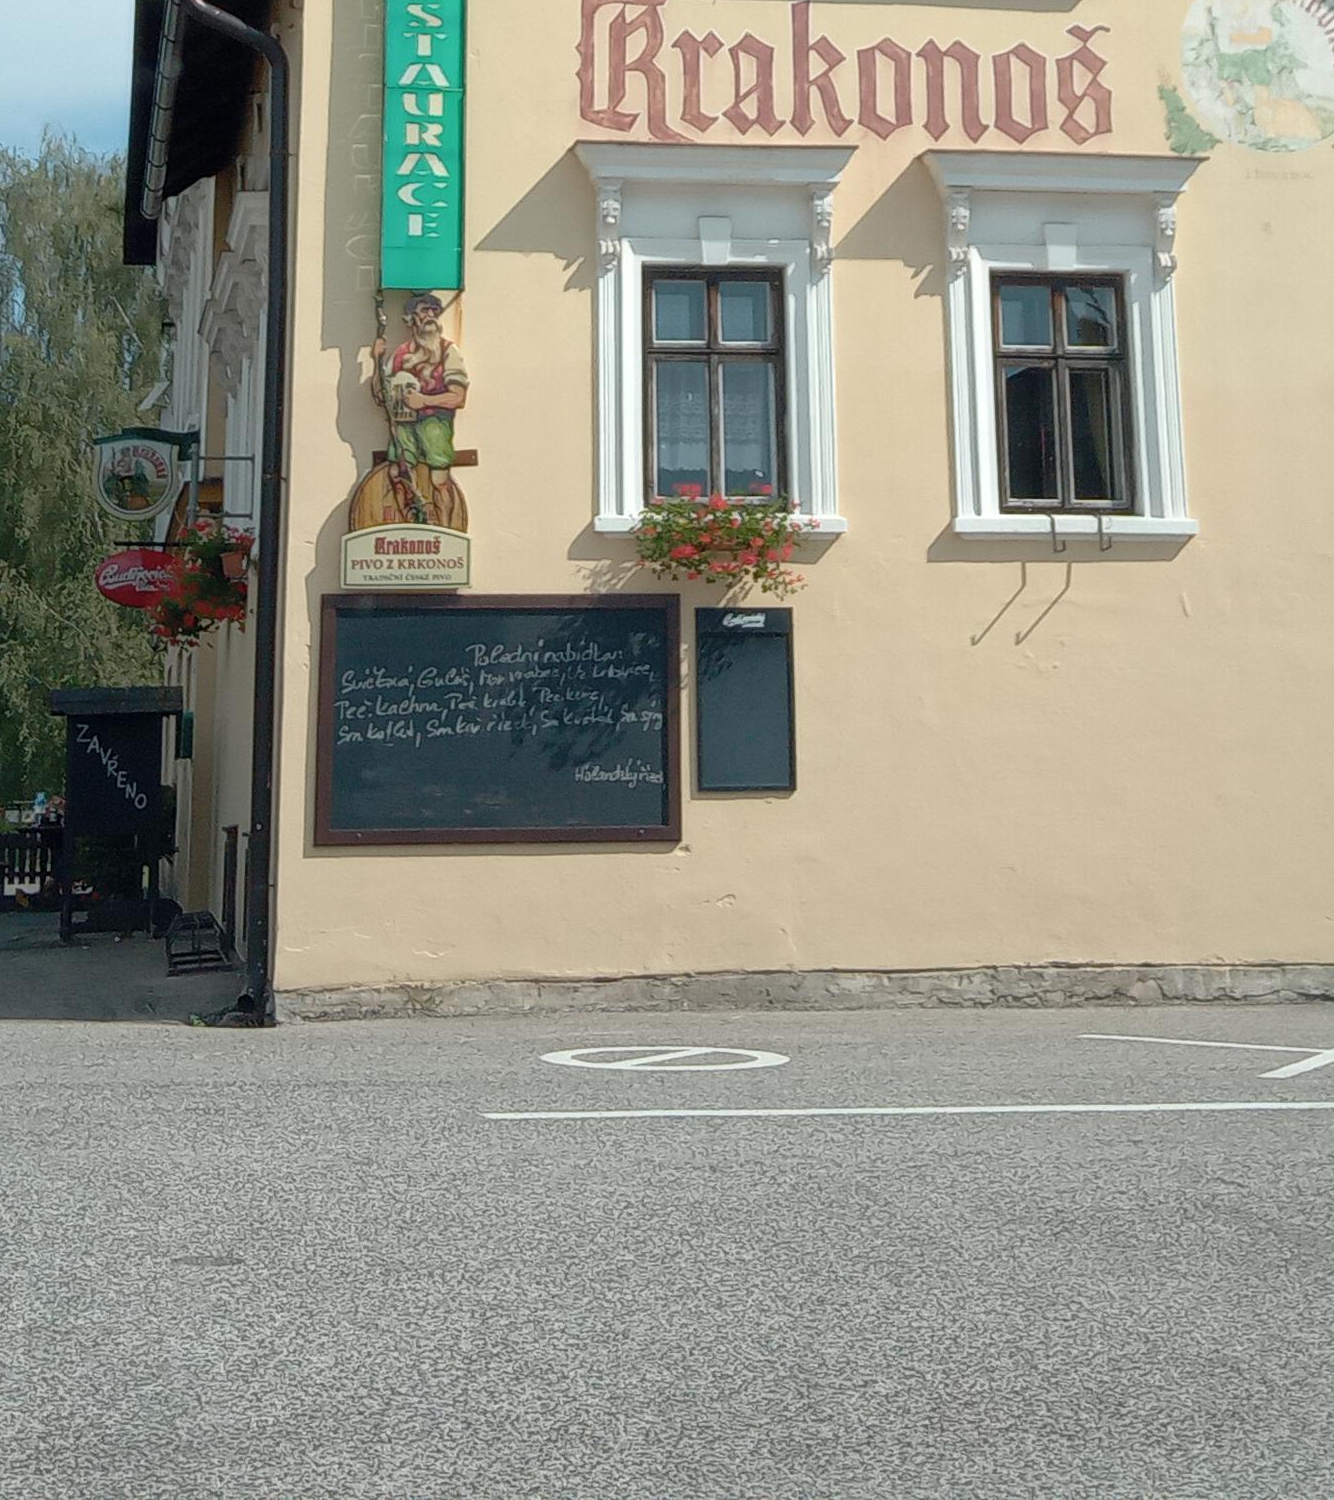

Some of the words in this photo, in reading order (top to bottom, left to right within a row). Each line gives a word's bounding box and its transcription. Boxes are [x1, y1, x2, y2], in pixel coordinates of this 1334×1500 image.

[374, 535, 441, 555] Krakonoš
[351, 559, 383, 570] PIVO
[386, 559, 394, 570] Z
[397, 556, 465, 570] KRKONOŠ
[76, 723, 147, 810] ZAVŘENO
